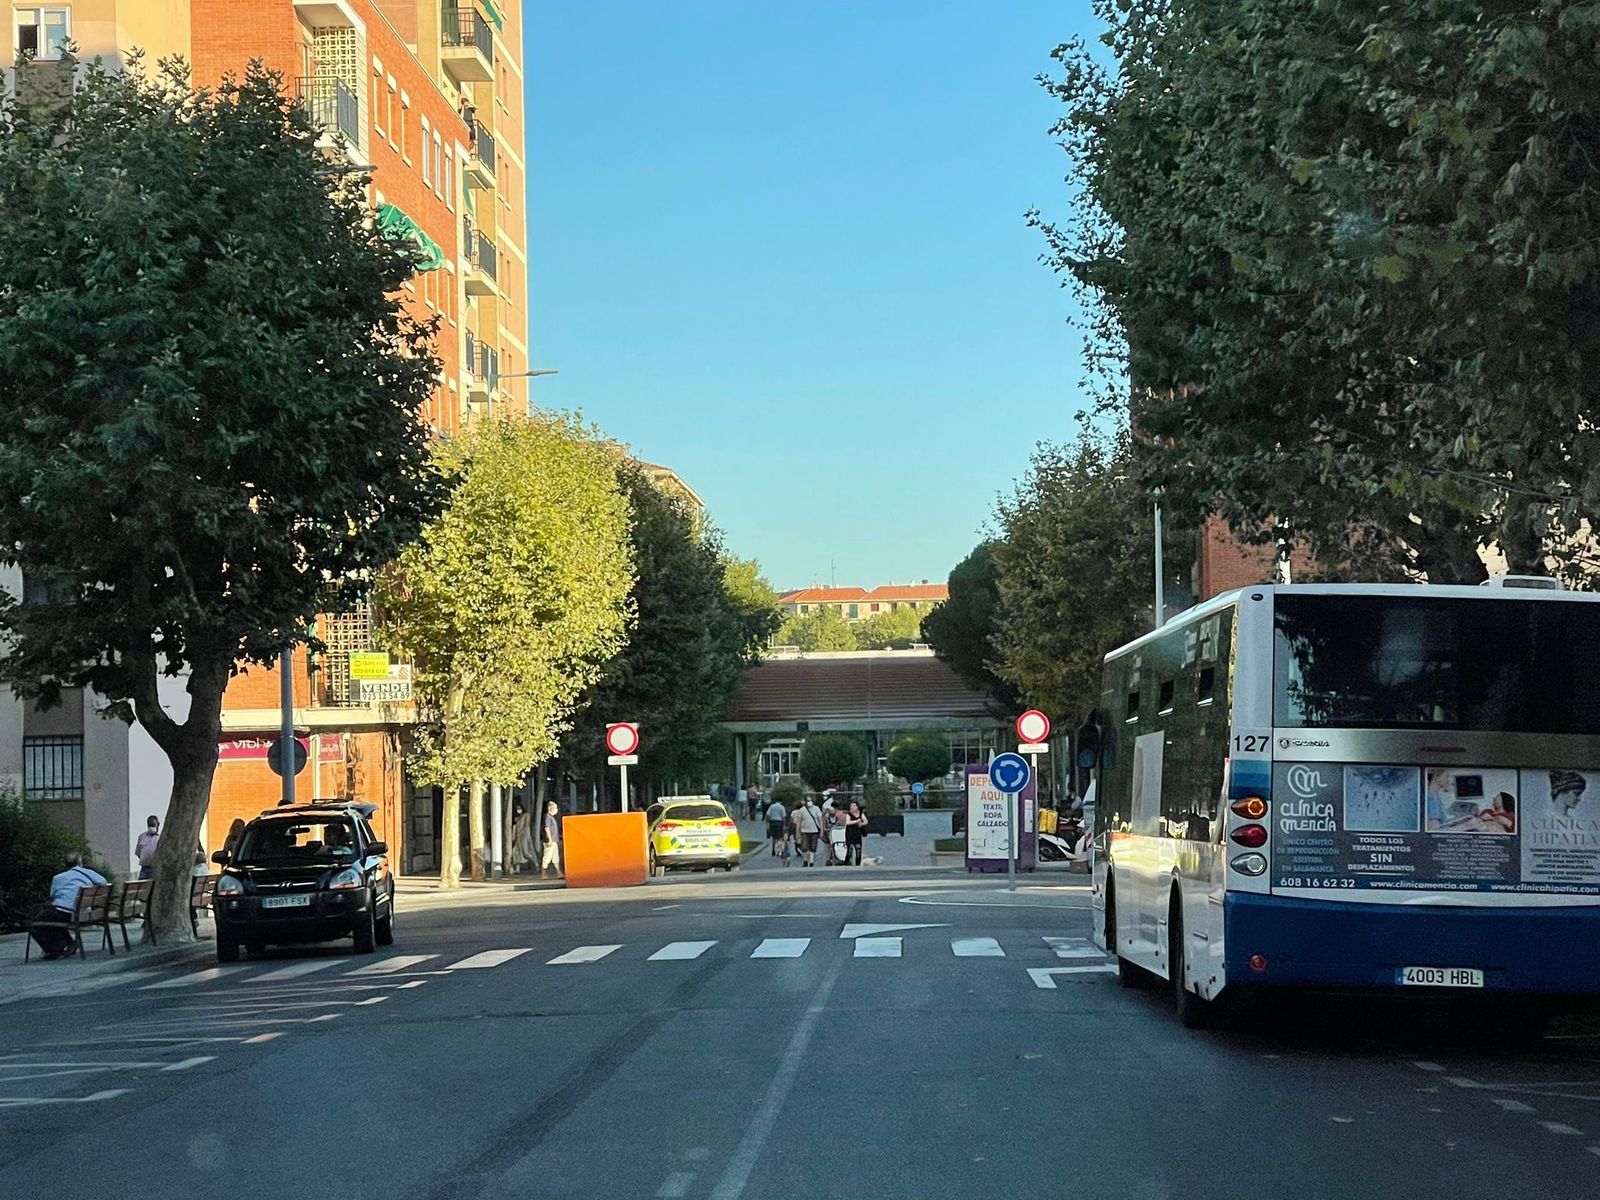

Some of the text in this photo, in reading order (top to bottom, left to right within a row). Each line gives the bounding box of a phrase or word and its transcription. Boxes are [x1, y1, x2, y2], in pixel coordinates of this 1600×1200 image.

[362, 683, 409, 693] VENDE
[362, 691, 410, 700] 923 12 54 89
[1234, 735, 1269, 752] 127
[983, 803, 1003, 811] TEXTIL
[1280, 799, 1334, 817] CLÍNICA
[1307, 838, 1334, 846] CENTRO
[1352, 844, 1412, 852] TRATAMIENTOS
[1370, 853, 1393, 863] SIN
[1293, 865, 1335, 873] SALAMANCA
[1348, 864, 1415, 872] DESPLAZAMIENTOS
[1280, 877, 1355, 888] 608 16 62 32
[1491, 883, 1599, 893] www.clinicahipatia.com
[268, 895, 307, 906] 8901 FSX
[1407, 968, 1479, 985] 4003 HBL
